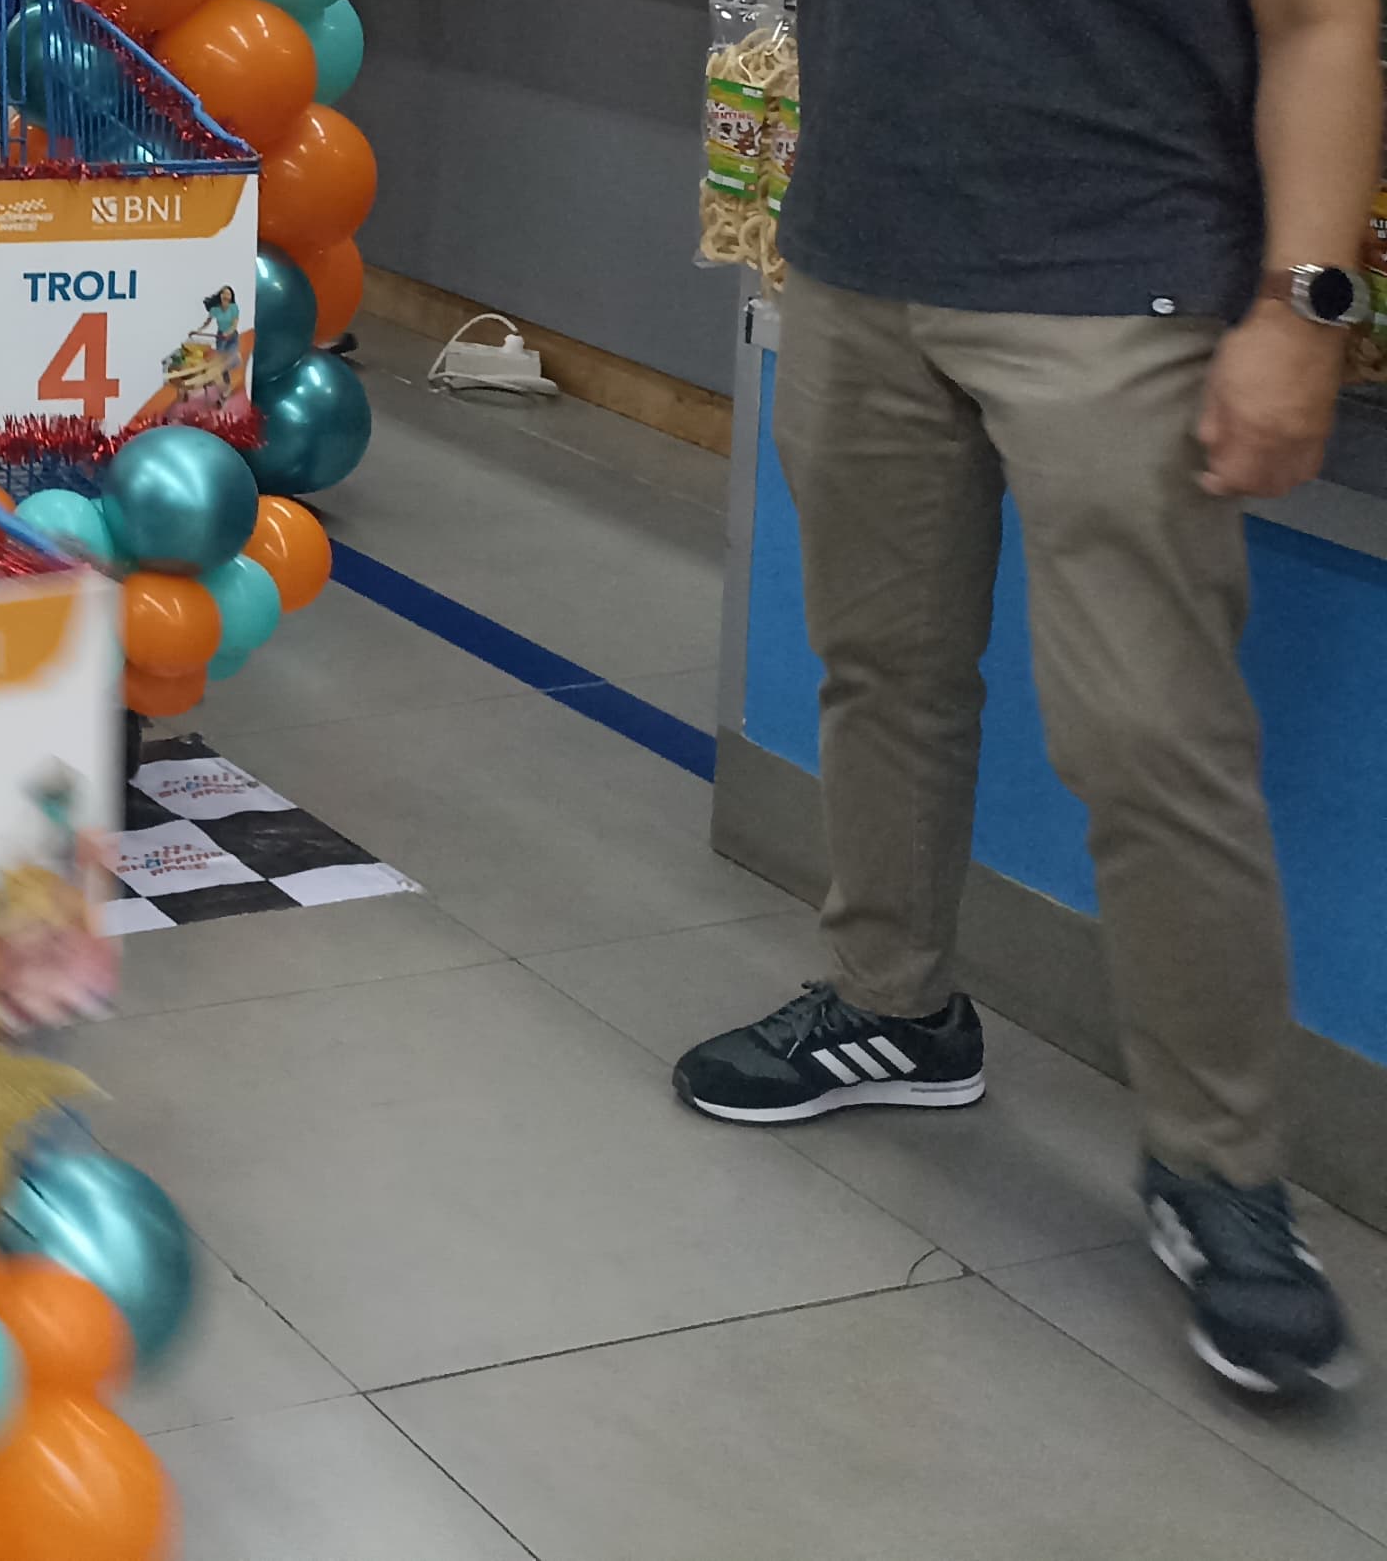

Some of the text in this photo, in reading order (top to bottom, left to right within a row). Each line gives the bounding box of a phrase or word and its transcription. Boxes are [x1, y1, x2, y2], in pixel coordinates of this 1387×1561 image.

[123, 194, 182, 224] BNI
[22, 269, 138, 303] TROLI
[37, 311, 121, 422] 4
